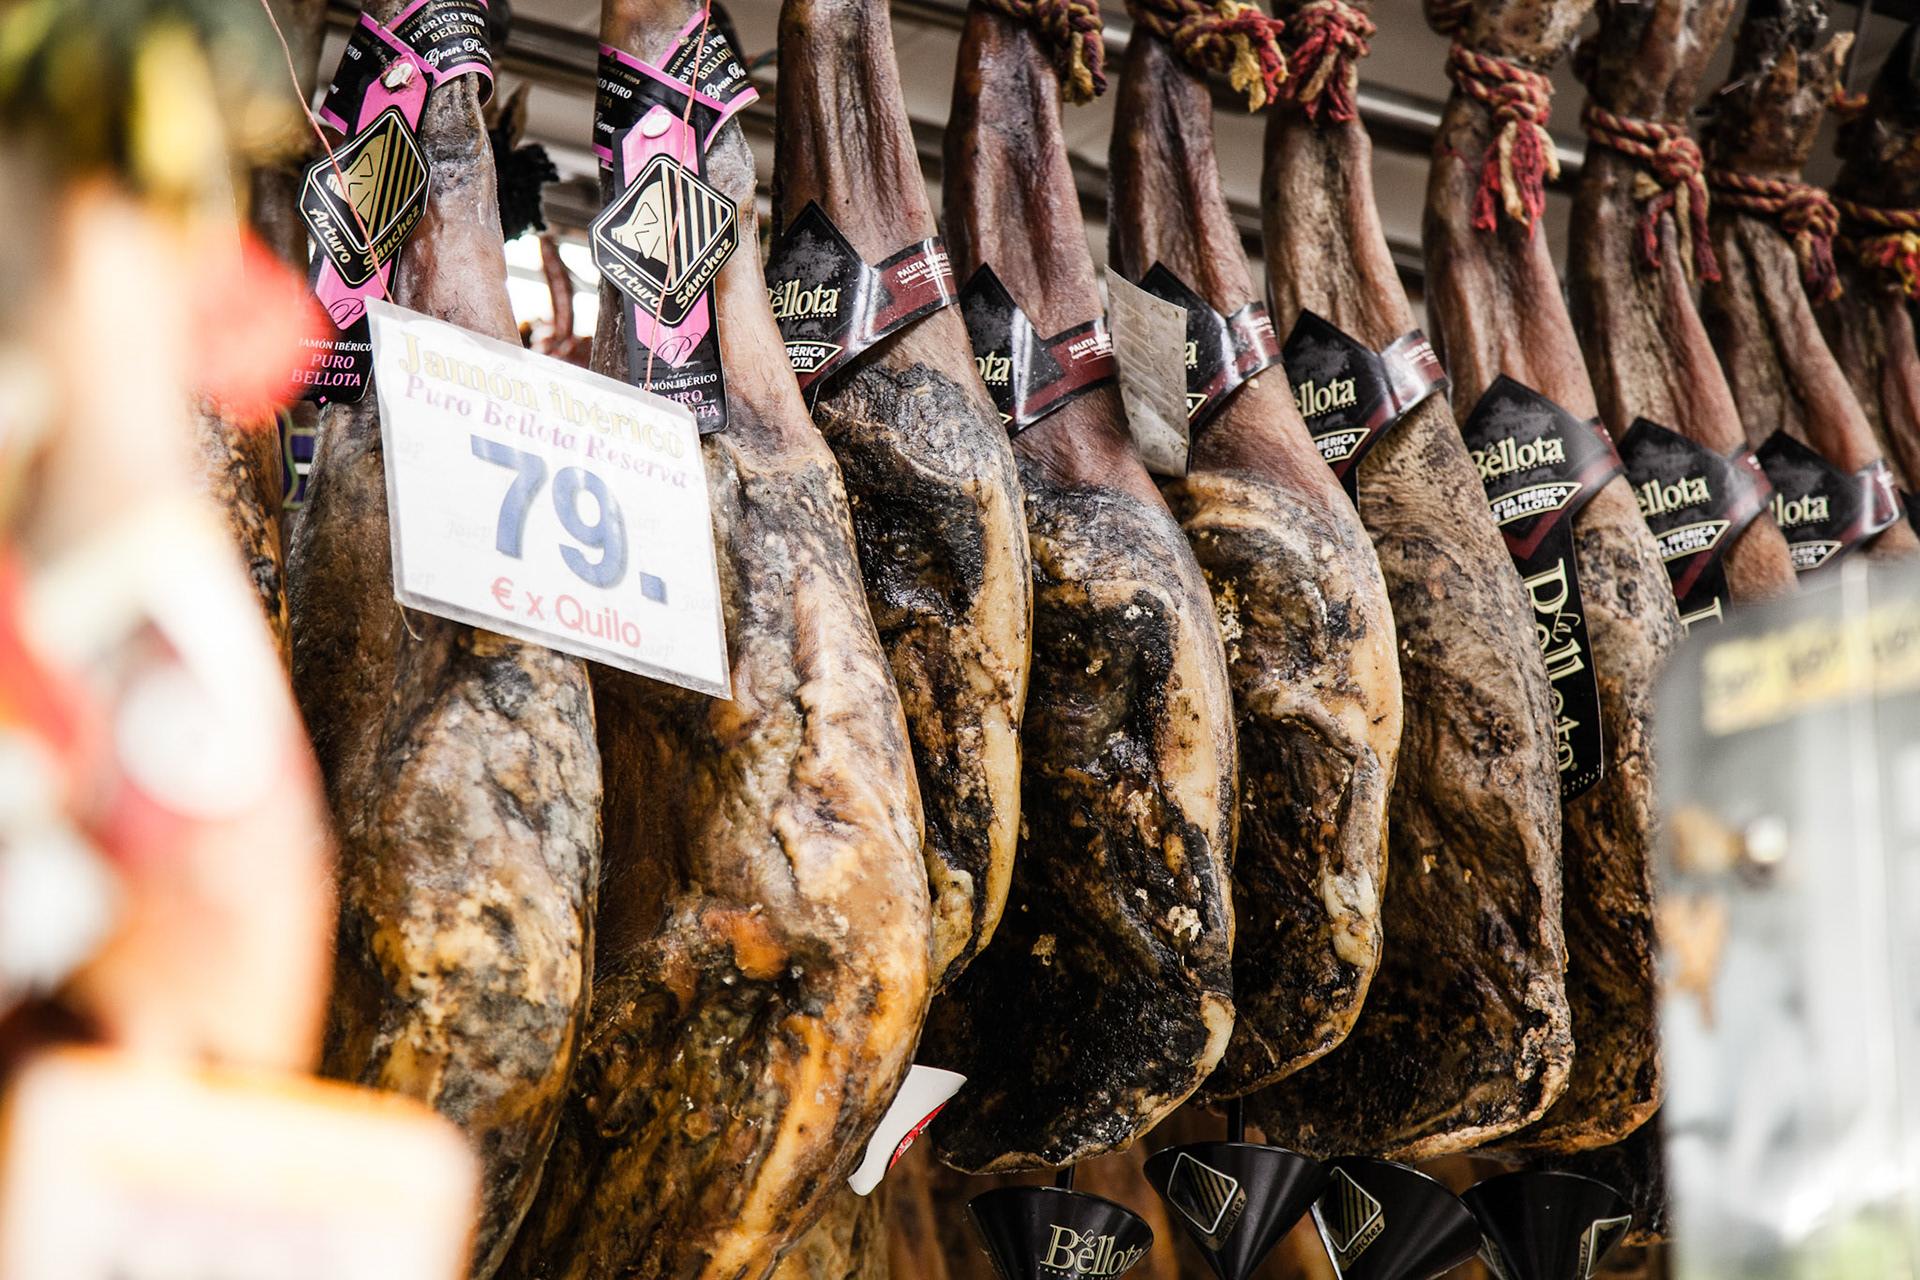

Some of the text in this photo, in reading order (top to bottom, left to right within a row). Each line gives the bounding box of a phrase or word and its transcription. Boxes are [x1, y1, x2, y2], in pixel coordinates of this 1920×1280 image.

[429, 24, 482, 43] BELLOTA
[424, 46, 462, 69] Gran
[678, 45, 713, 83] BÉRCO
[697, 48, 733, 81] BELLOT
[606, 81, 633, 99] PURO
[702, 76, 734, 101] Gran
[308, 206, 421, 272] Arturo Sánchez
[606, 238, 732, 309] Arturo Sánchez
[896, 260, 926, 279] PALETA
[299, 338, 373, 352] JAMÓN IBÉRICO
[786, 344, 826, 358] BÉRICA
[1068, 337, 1097, 355] PALETA
[310, 353, 355, 370] PURO
[398, 330, 541, 412] Jamón
[291, 369, 362, 387] BELLOTA
[674, 373, 718, 390] IBÉRICO
[1294, 378, 1357, 418] llota
[405, 373, 688, 489] Puro Bellota Reserva
[1316, 433, 1357, 451] BÉRICA
[1470, 436, 1565, 480] Bellota
[1517, 486, 1568, 504] IBÉRICA
[1637, 477, 1710, 517] ellota
[1503, 497, 1558, 519] BELLOTA
[1770, 493, 1829, 527] lota
[1661, 537, 1709, 558] ELLOTA
[525, 590, 547, 621] x
[555, 593, 643, 650] Quilo
[1524, 557, 1585, 772] Bllt
